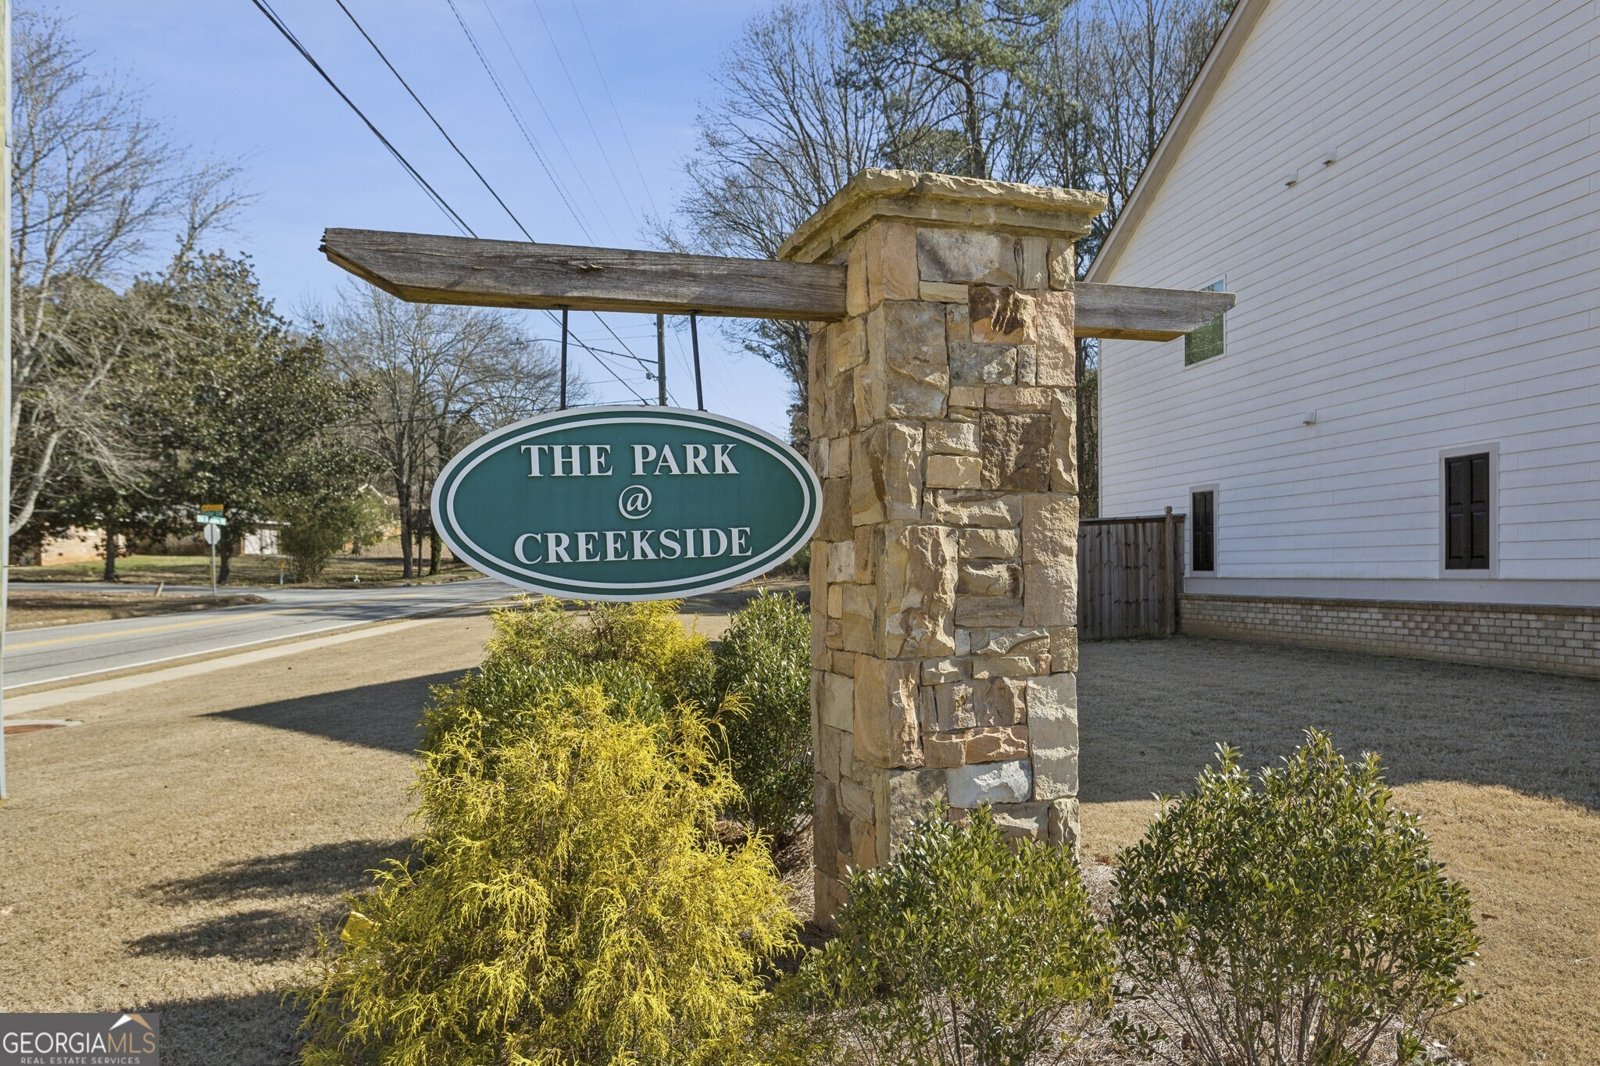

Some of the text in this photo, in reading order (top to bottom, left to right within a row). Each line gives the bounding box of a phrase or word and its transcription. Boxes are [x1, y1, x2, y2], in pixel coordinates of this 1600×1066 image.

[520, 443, 740, 477] THE PARK
[618, 484, 653, 520] @
[514, 527, 753, 565] CREEKSIDE
